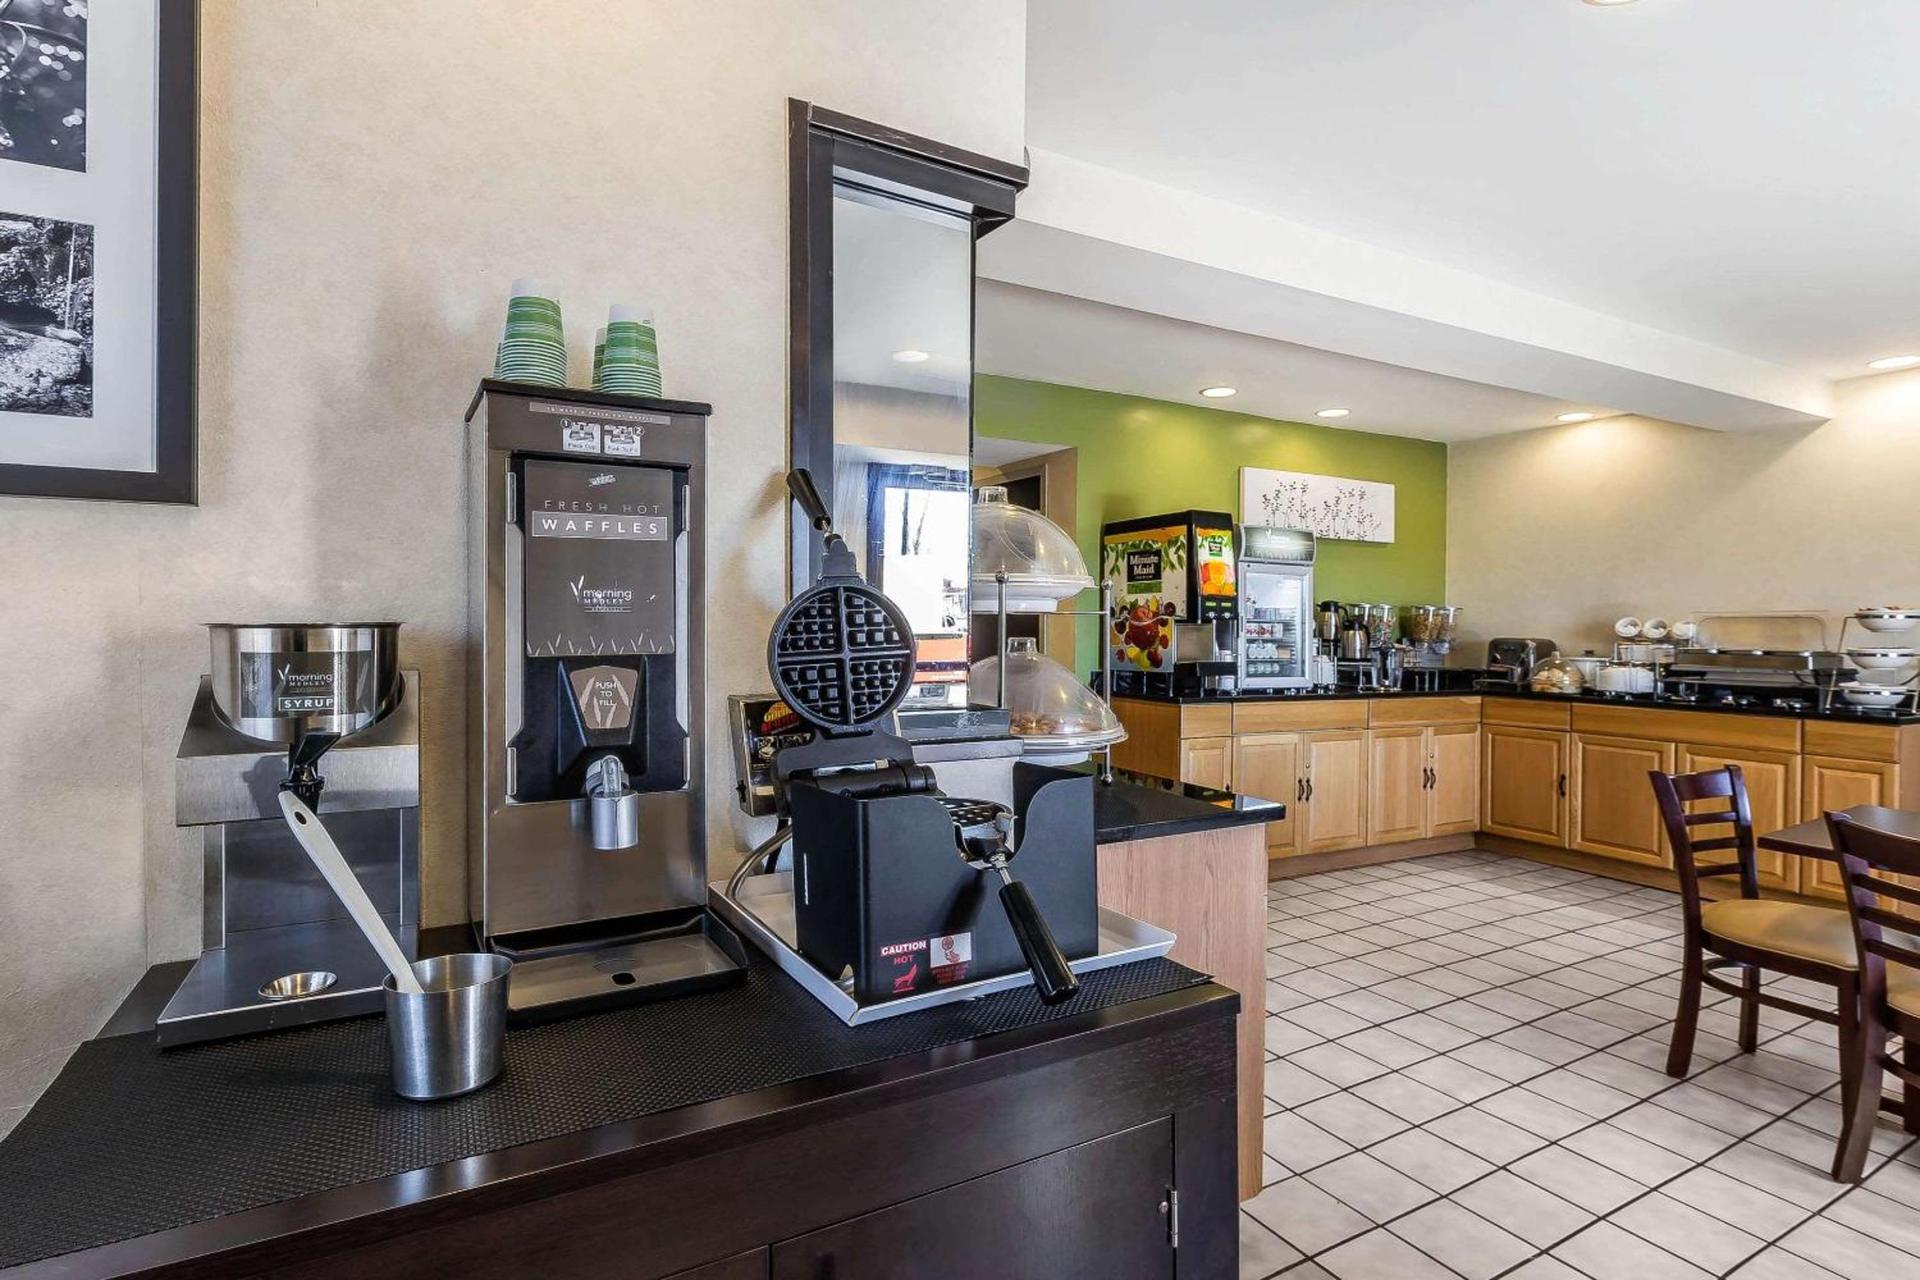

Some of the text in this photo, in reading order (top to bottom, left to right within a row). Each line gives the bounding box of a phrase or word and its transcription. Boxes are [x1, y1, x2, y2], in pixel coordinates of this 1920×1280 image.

[544, 500, 660, 514] FRESH HOT
[542, 519, 658, 534] WAFFLES
[1129, 554, 1160, 566] Minute
[1133, 564, 1155, 576] Maid
[583, 588, 632, 600] morning
[289, 673, 333, 683] morning
[596, 681, 617, 689] PUSH
[284, 699, 334, 709] SYRUP
[881, 940, 927, 956] CAUTION
[894, 954, 914, 965] HOT
